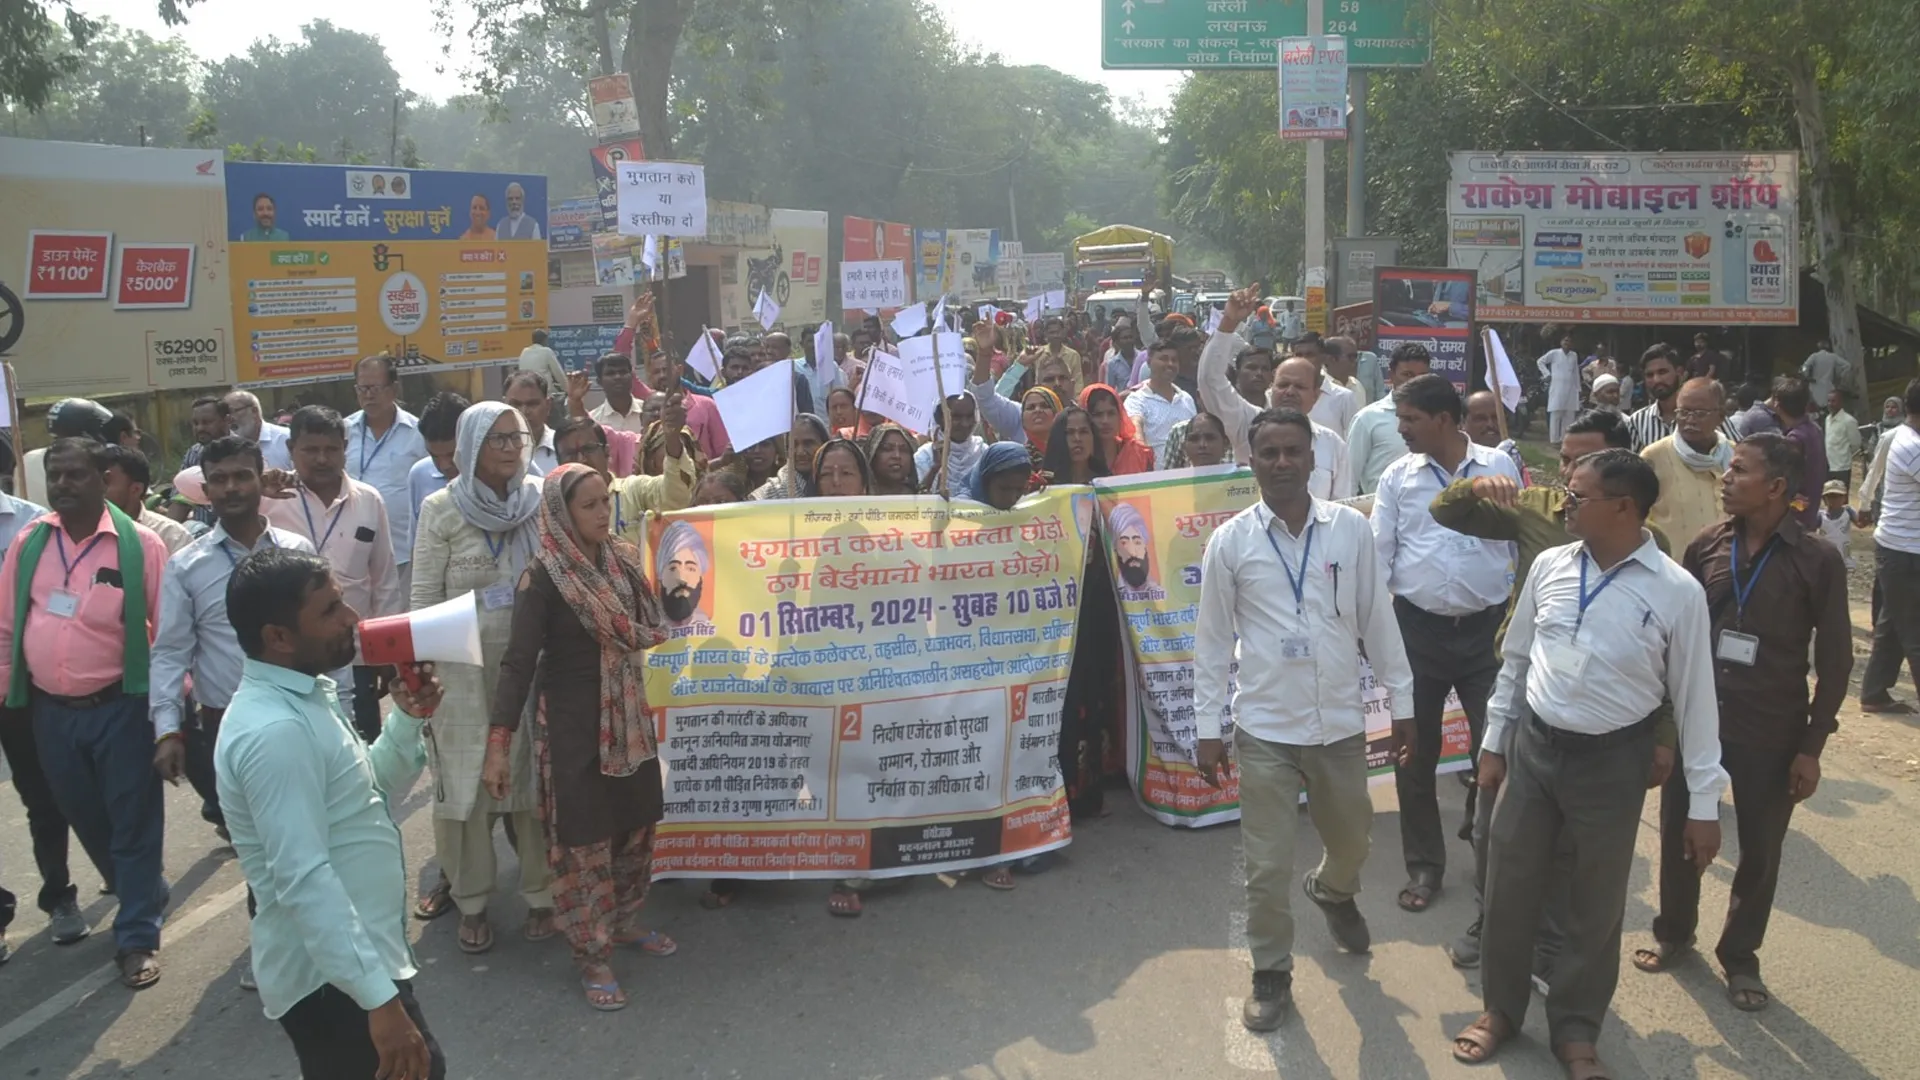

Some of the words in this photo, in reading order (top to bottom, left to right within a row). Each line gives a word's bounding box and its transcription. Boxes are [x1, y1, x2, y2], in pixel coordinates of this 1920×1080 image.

[1340, 2, 1360, 13] 58
[1206, 20, 1268, 33] लखनऊ
[1328, 21, 1358, 33] 264
[1173, 37, 1190, 49] का
[1197, 36, 1239, 49] संकल्प
[1186, 49, 1220, 63] लोक
[1228, 49, 1274, 63] निर्माण
[1283, 44, 1316, 66] बरेली
[1317, 51, 1346, 65] PVC
[626, 171, 672, 185] भुगतान
[676, 172, 696, 186] करो
[658, 193, 672, 205] या
[1460, 176, 1556, 210] राकेश
[1564, 177, 1701, 214] मोबाइल
[1710, 176, 1782, 210] शॉप
[302, 204, 342, 227] स्मार्ट
[345, 204, 370, 227] बनें
[383, 209, 425, 234] सुरक्षा
[427, 205, 451, 234] चुनें
[631, 212, 676, 226] इस्तीफा
[681, 213, 693, 228] दो
[43, 248, 69, 262] डाउन
[72, 247, 98, 263] पेमेंट
[136, 259, 178, 273] कैशबैक
[1749, 263, 1781, 275] ब्याज
[1751, 276, 1763, 286] दर
[1766, 276, 1780, 286] पर
[388, 302, 420, 319] सुरक्षा
[154, 338, 217, 355] ₹62900
[1440, 340, 1465, 353] समय
[1448, 356, 1467, 371] करें।
[865, 509, 886, 522] पीड़ित
[887, 509, 919, 521] जमाकर्ता
[921, 508, 945, 520] परिवार
[739, 536, 842, 568] भुगतान
[847, 527, 904, 554] करो
[910, 529, 945, 551] या
[948, 523, 1014, 547] सत्ता
[766, 572, 812, 594] ठग
[818, 559, 922, 589] बेईमानो
[928, 560, 995, 582] भारत
[1001, 549, 1061, 578] छोड़ो।
[739, 611, 772, 638] 01
[777, 601, 864, 638] सितम्बर,
[871, 596, 933, 627] 2024
[952, 592, 998, 627] सुबह
[1006, 588, 1030, 615] 10
[1033, 578, 1063, 611] बजे
[1065, 576, 1079, 608] से
[1152, 611, 1180, 626] भारत
[696, 620, 716, 636] सिंह
[648, 645, 690, 674] सम्पूर्ण
[692, 649, 729, 666] भारत
[731, 646, 751, 666] वर्ष
[754, 648, 769, 666] के
[771, 645, 812, 669] प्रत्येक
[814, 641, 872, 665] कलेक्टर,
[874, 633, 921, 658] तहसील,
[924, 633, 976, 655] राजभवन,
[979, 626, 1040, 649] विधानसभा,
[1139, 635, 1161, 654] और
[671, 675, 699, 696] और
[701, 673, 770, 694] राजनेताओं
[772, 675, 787, 694] के
[789, 680, 836, 696] आवास
[838, 678, 855, 692] पर
[857, 661, 948, 691] अनिश्चितकालीन
[950, 656, 1005, 681] असहयोग
[1006, 652, 1050, 676] आंदोलन
[1146, 669, 1174, 688] भुगतान
[1175, 666, 1187, 681] की
[1014, 691, 1025, 716] 3
[1032, 687, 1058, 705] भारतीय
[675, 713, 709, 732] भुगतान
[710, 710, 725, 727] की
[755, 710, 767, 727] के
[768, 712, 808, 728] अधिकार
[843, 711, 859, 736] 2
[872, 721, 905, 744] निर्दोष
[943, 715, 957, 737] को
[959, 716, 989, 740] सुरक्षा
[1028, 714, 1045, 728] धारा
[670, 734, 700, 752] कानून
[702, 731, 748, 749] अनियमित
[750, 734, 770, 748] जमा
[669, 755, 698, 771] पाबंदी
[699, 754, 746, 770] अधिनियम
[747, 756, 775, 770] 2019
[777, 752, 788, 769] के
[789, 756, 810, 770] तहत
[878, 751, 918, 772] सम्मान,
[920, 748, 959, 769] रोजगार
[961, 741, 982, 765] और
[673, 777, 703, 794] प्रत्येक
[704, 776, 722, 793] ठगी
[723, 775, 751, 793] पीड़ित
[752, 773, 788, 792] निवेशक
[909, 779, 926, 797] का
[927, 774, 972, 796] अधिकार
[974, 771, 991, 791] दो।
[1014, 775, 1031, 792] रहित
[697, 799, 712, 814] का
[713, 800, 720, 813] 2
[721, 797, 730, 814] से
[732, 800, 739, 813] 3
[741, 800, 762, 817] गुणा
[763, 798, 797, 817] भुगतान
[791, 832, 822, 848] परिवार
[718, 853, 739, 868] रहित
[764, 852, 796, 868] निर्माण
[798, 852, 829, 867] निर्माण
